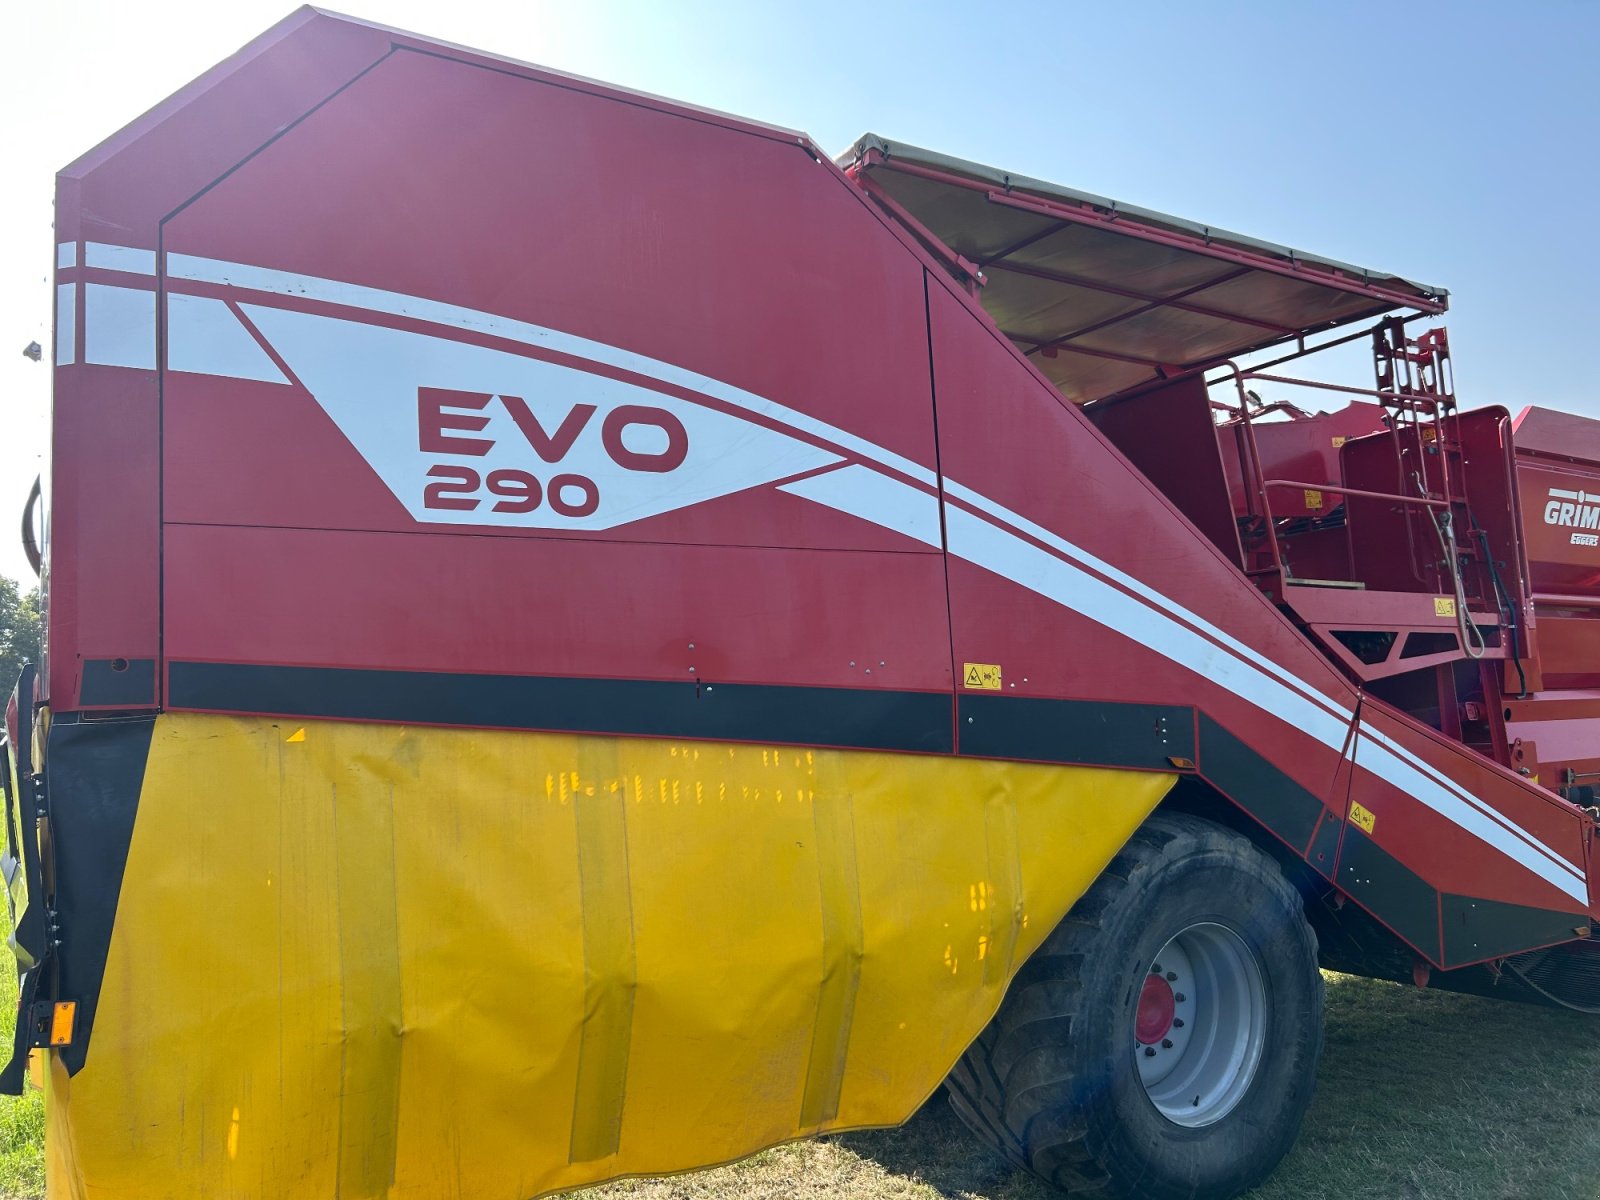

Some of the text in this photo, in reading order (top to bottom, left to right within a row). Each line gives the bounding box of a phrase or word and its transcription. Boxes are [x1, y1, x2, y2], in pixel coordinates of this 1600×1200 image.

[418, 386, 689, 473] EVO
[423, 464, 600, 518] 290
[1544, 500, 1600, 530] GRIM
